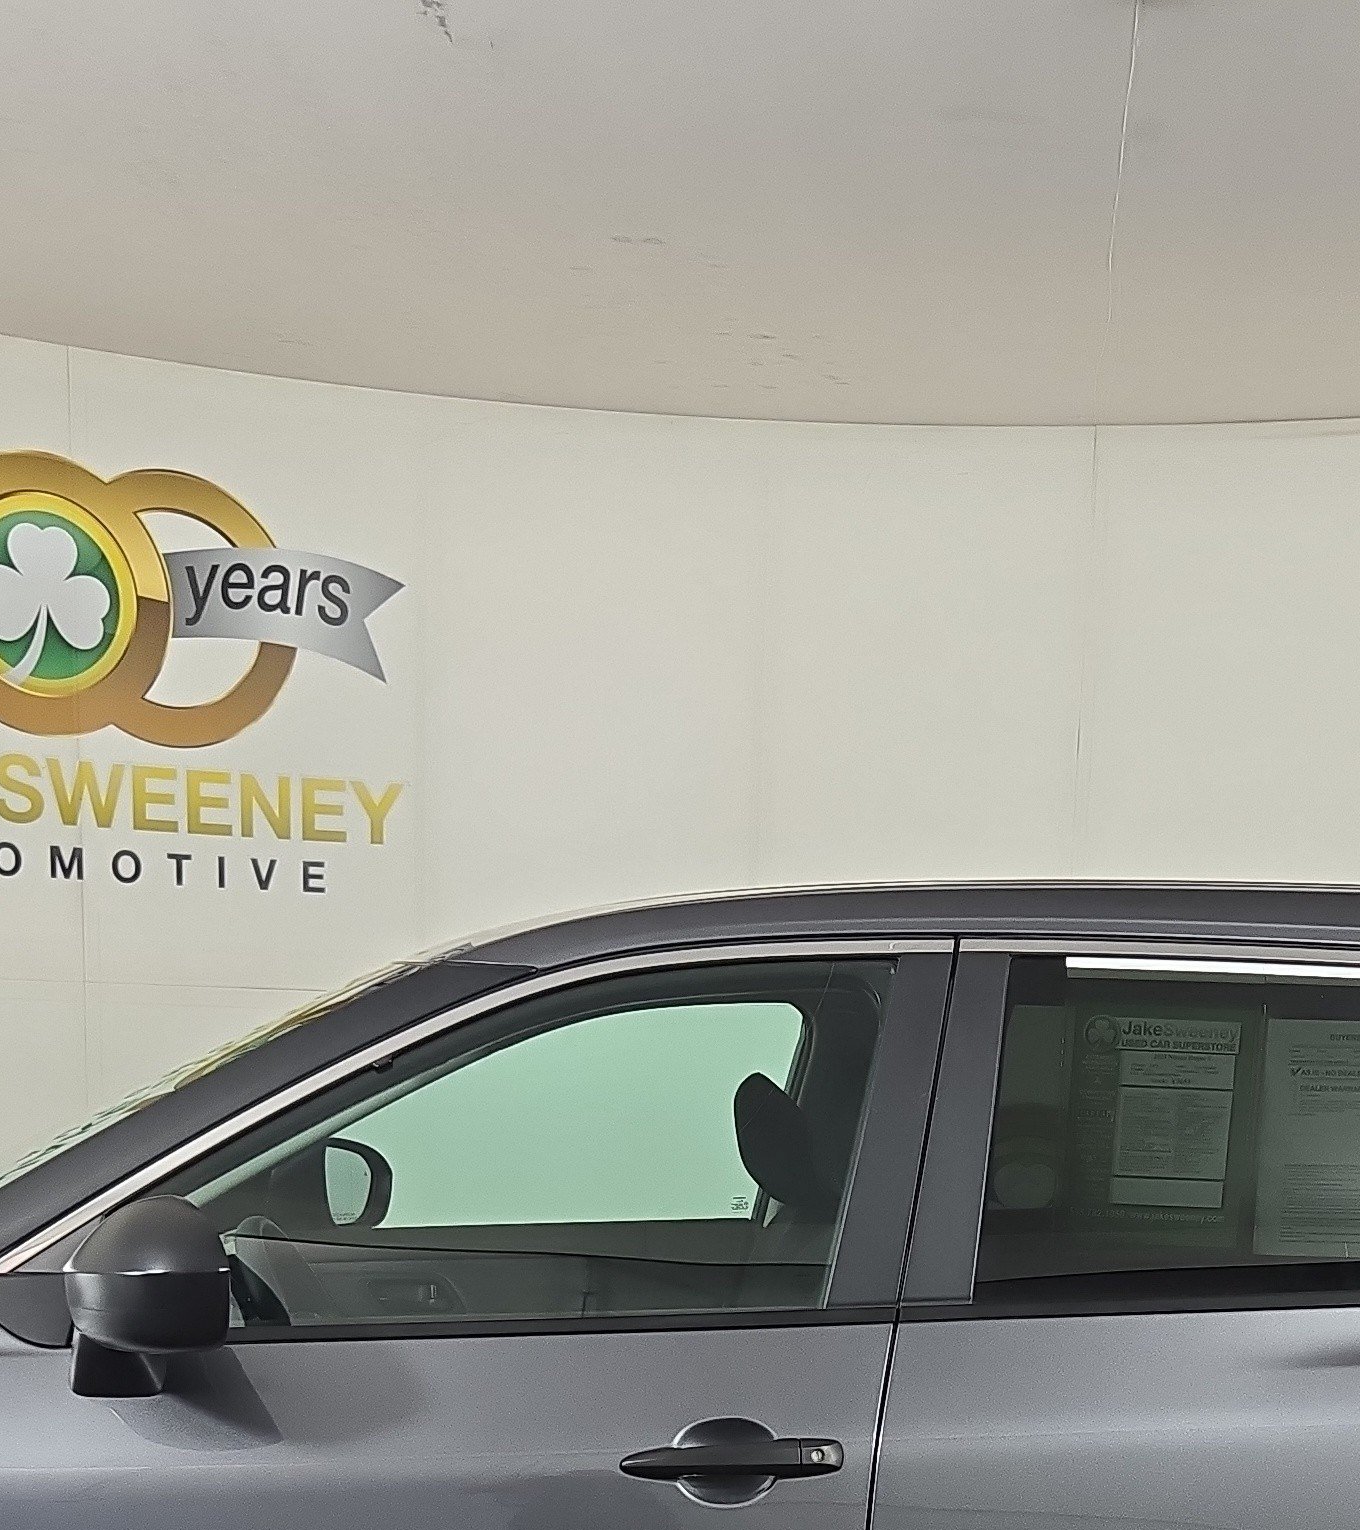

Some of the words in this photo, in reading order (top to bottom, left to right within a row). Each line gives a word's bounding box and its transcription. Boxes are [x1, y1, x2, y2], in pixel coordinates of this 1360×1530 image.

[183, 560, 351, 627] years
[1149, 1039, 1171, 1049] CAR
[1172, 1041, 1237, 1052] SUPERSTORE
